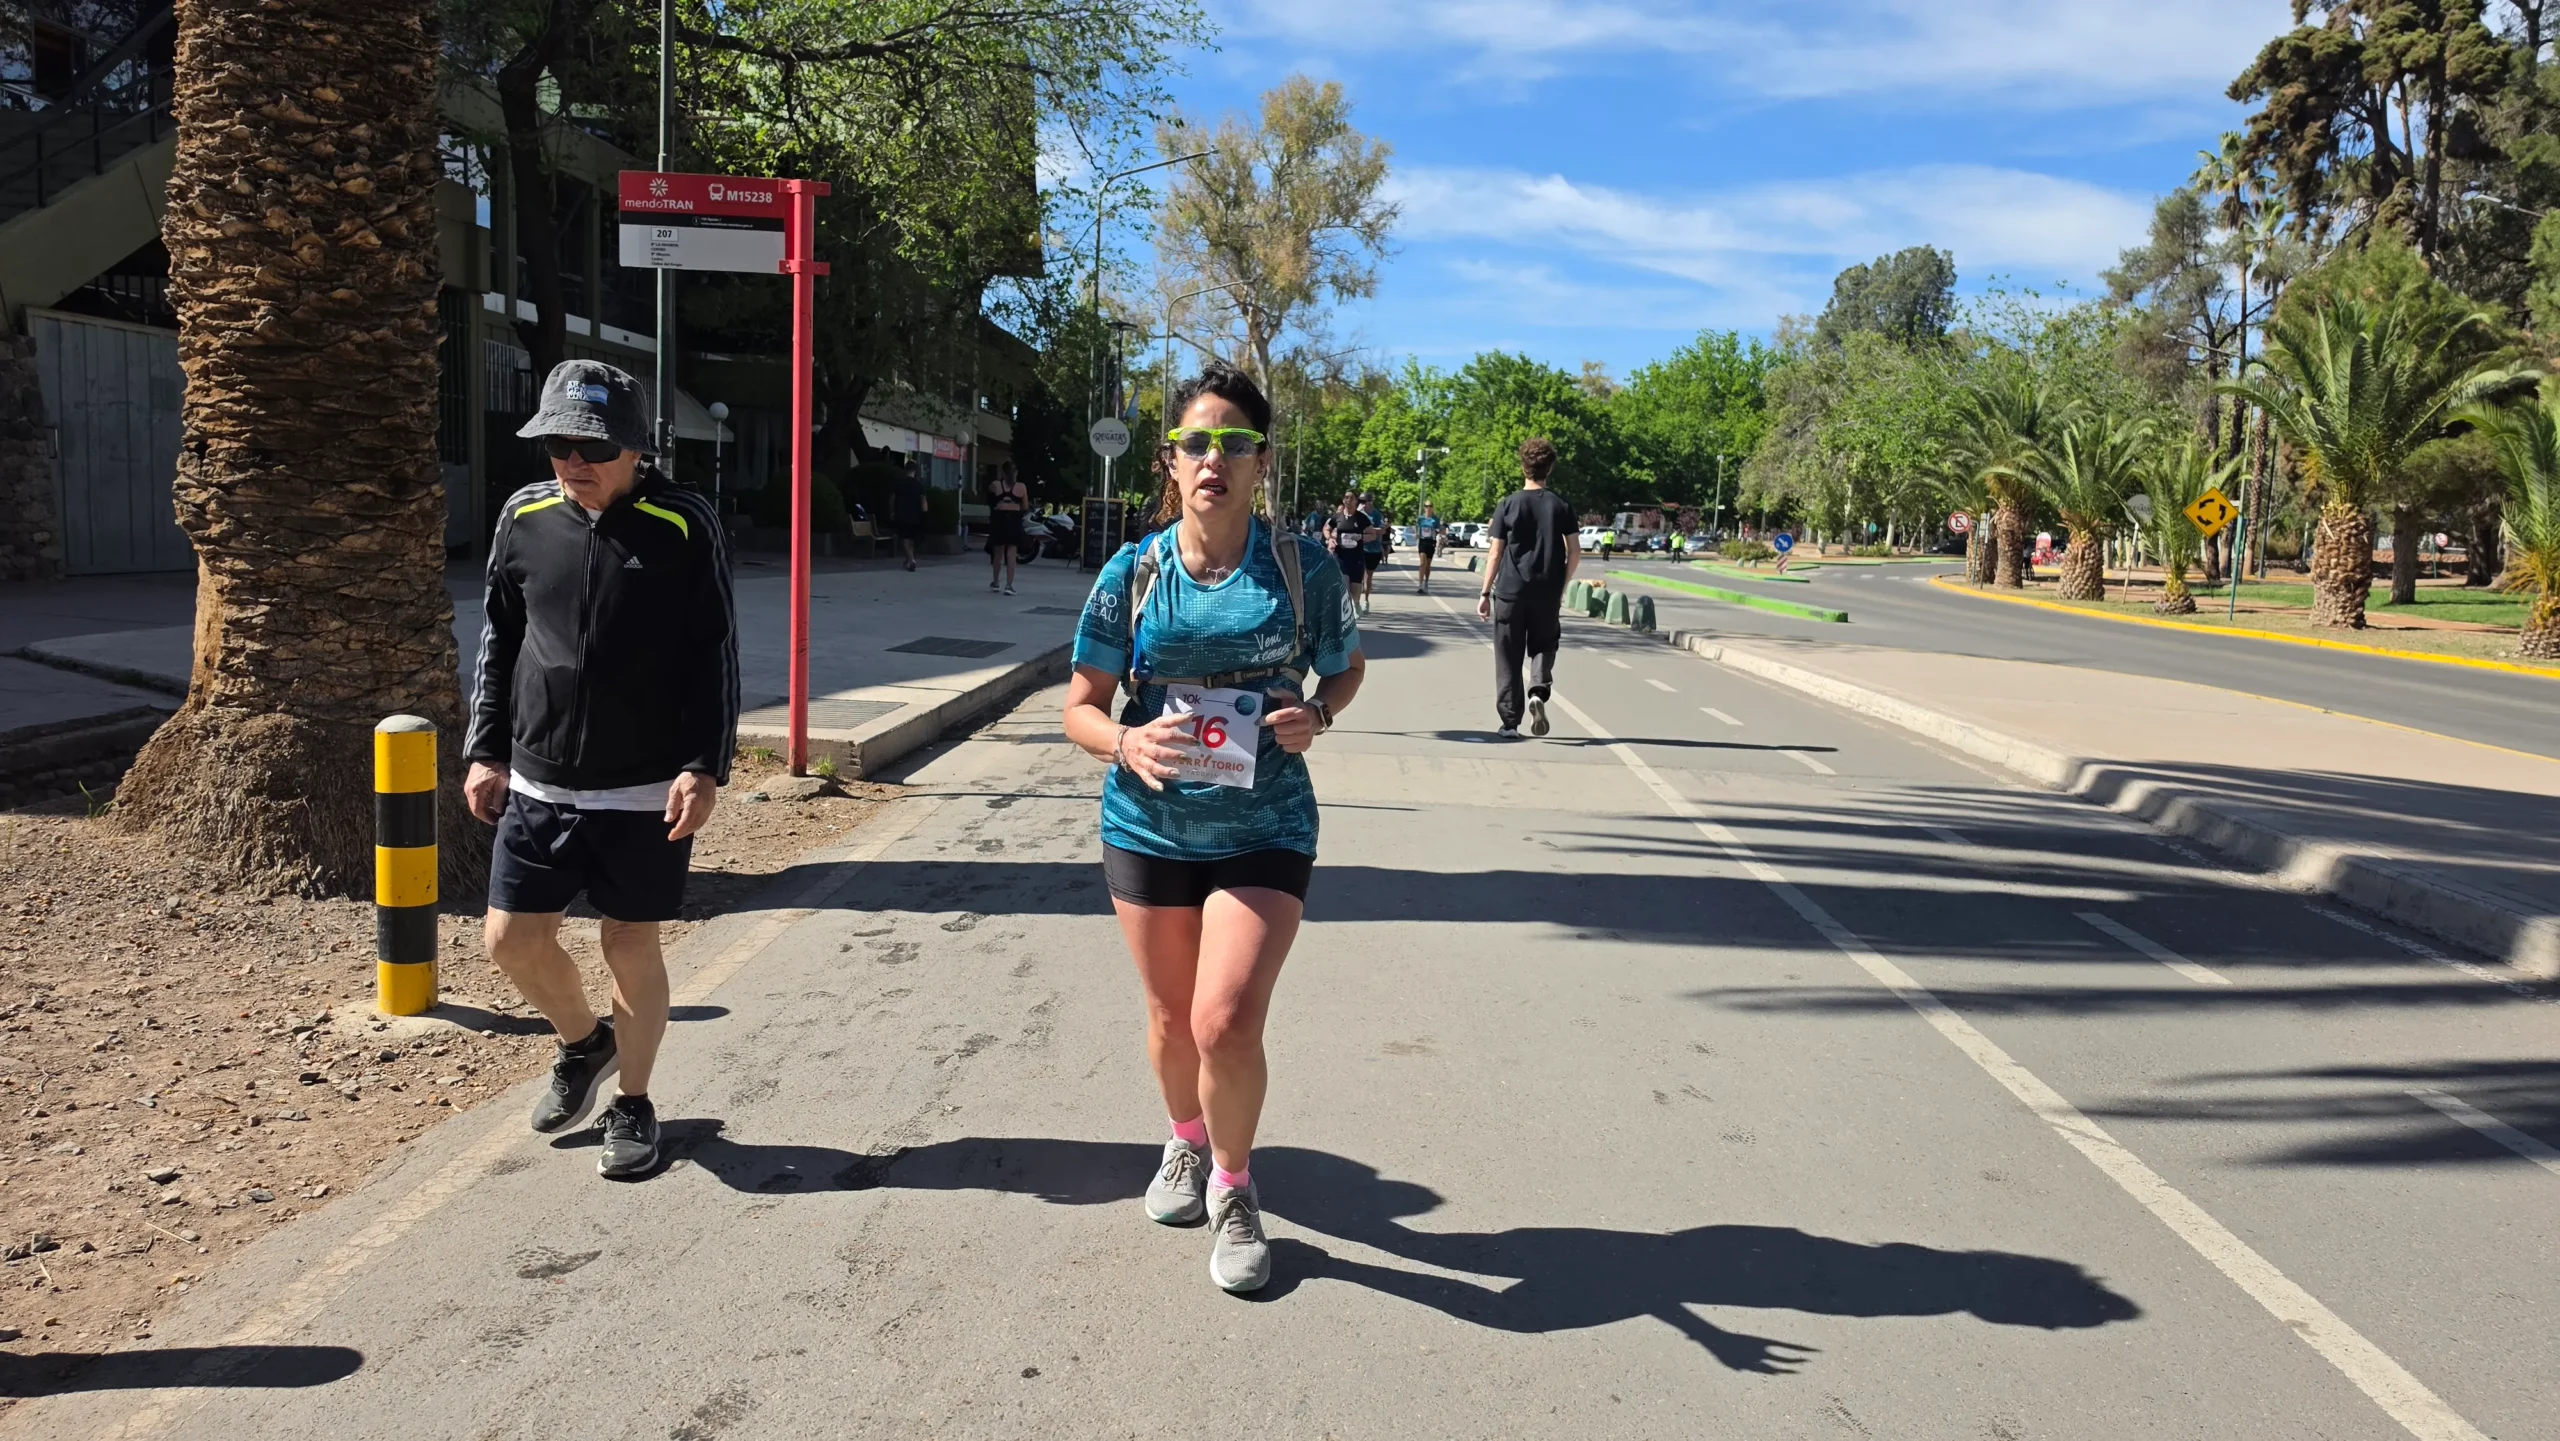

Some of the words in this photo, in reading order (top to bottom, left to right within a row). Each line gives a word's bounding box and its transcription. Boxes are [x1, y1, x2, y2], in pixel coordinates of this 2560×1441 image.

[727, 190, 773, 204] M15238
[625, 198, 693, 210] mendoTRAN
[656, 229, 672, 238] 207
[1092, 432, 1127, 445] REGATAS
[1191, 714, 1230, 749] 16
